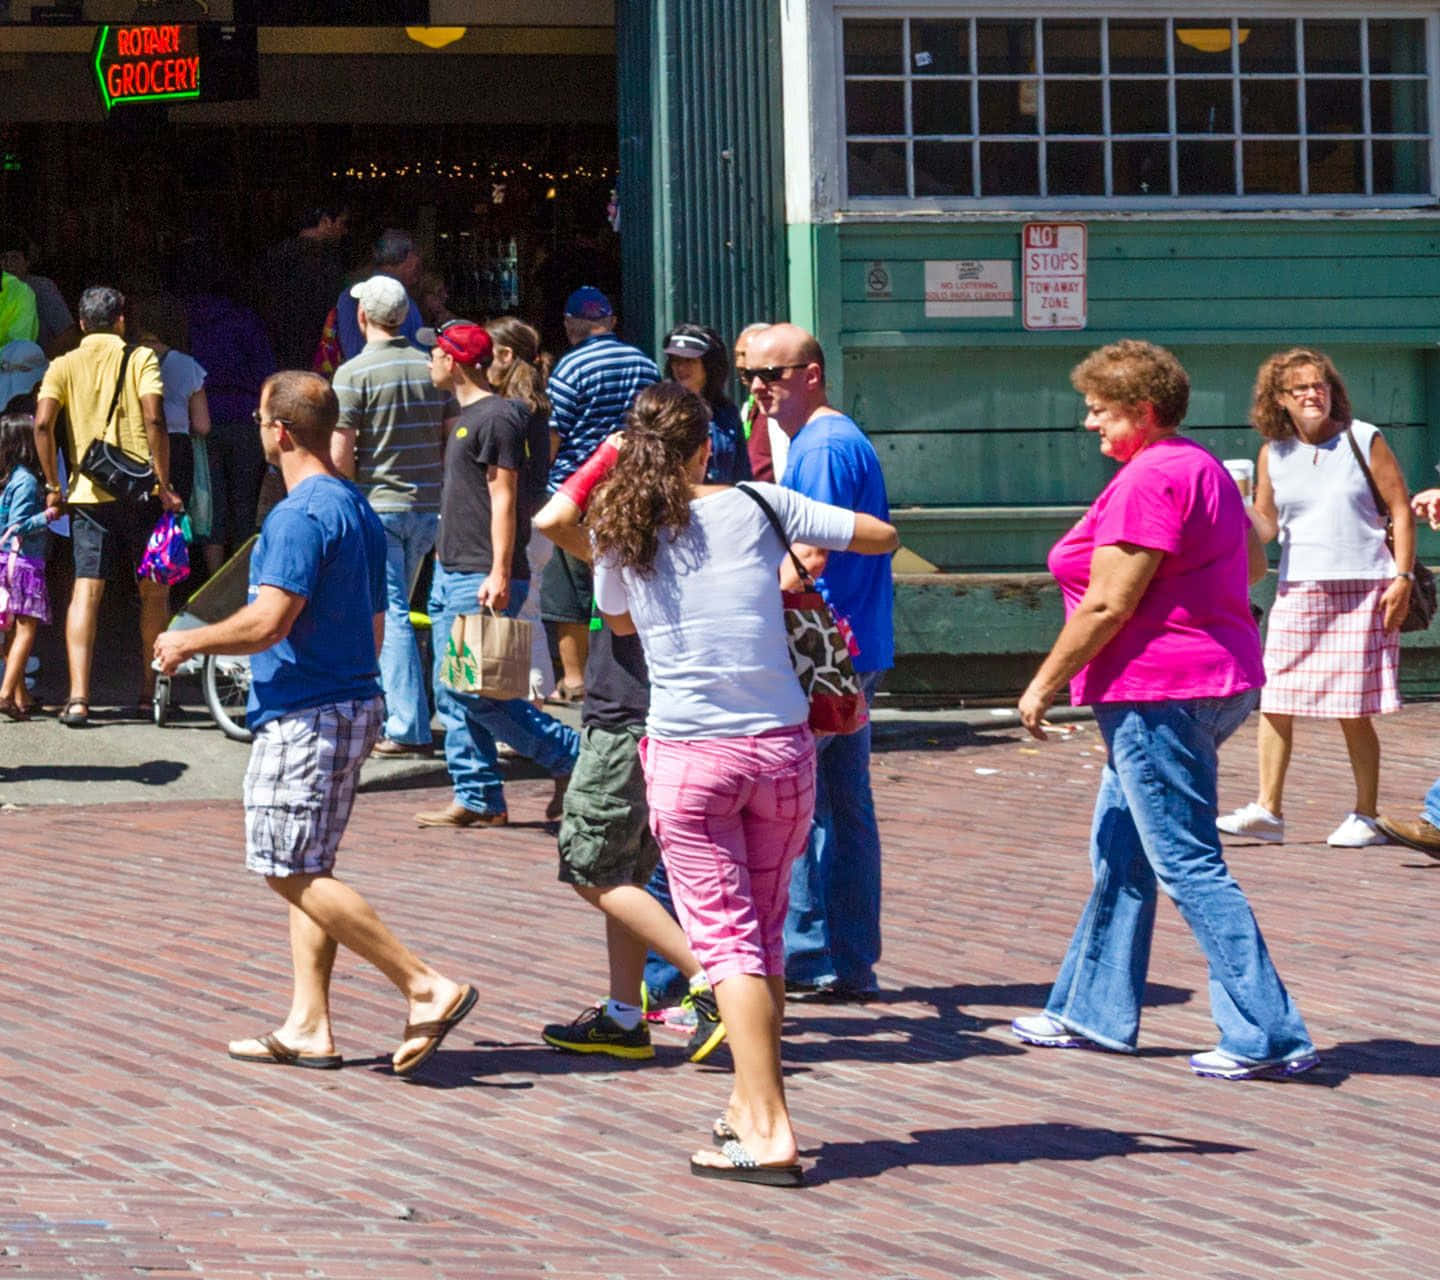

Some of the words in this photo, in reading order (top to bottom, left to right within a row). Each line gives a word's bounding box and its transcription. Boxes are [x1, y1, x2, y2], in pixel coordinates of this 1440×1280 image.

[118, 24, 180, 56] ROTARY
[107, 56, 200, 97] GROCERY
[1030, 226, 1053, 246] NO
[1031, 253, 1080, 271] STOPS
[941, 281, 953, 289] NO
[1030, 281, 1080, 294] TOW-AWAY
[1041, 296, 1070, 309] ZONE
